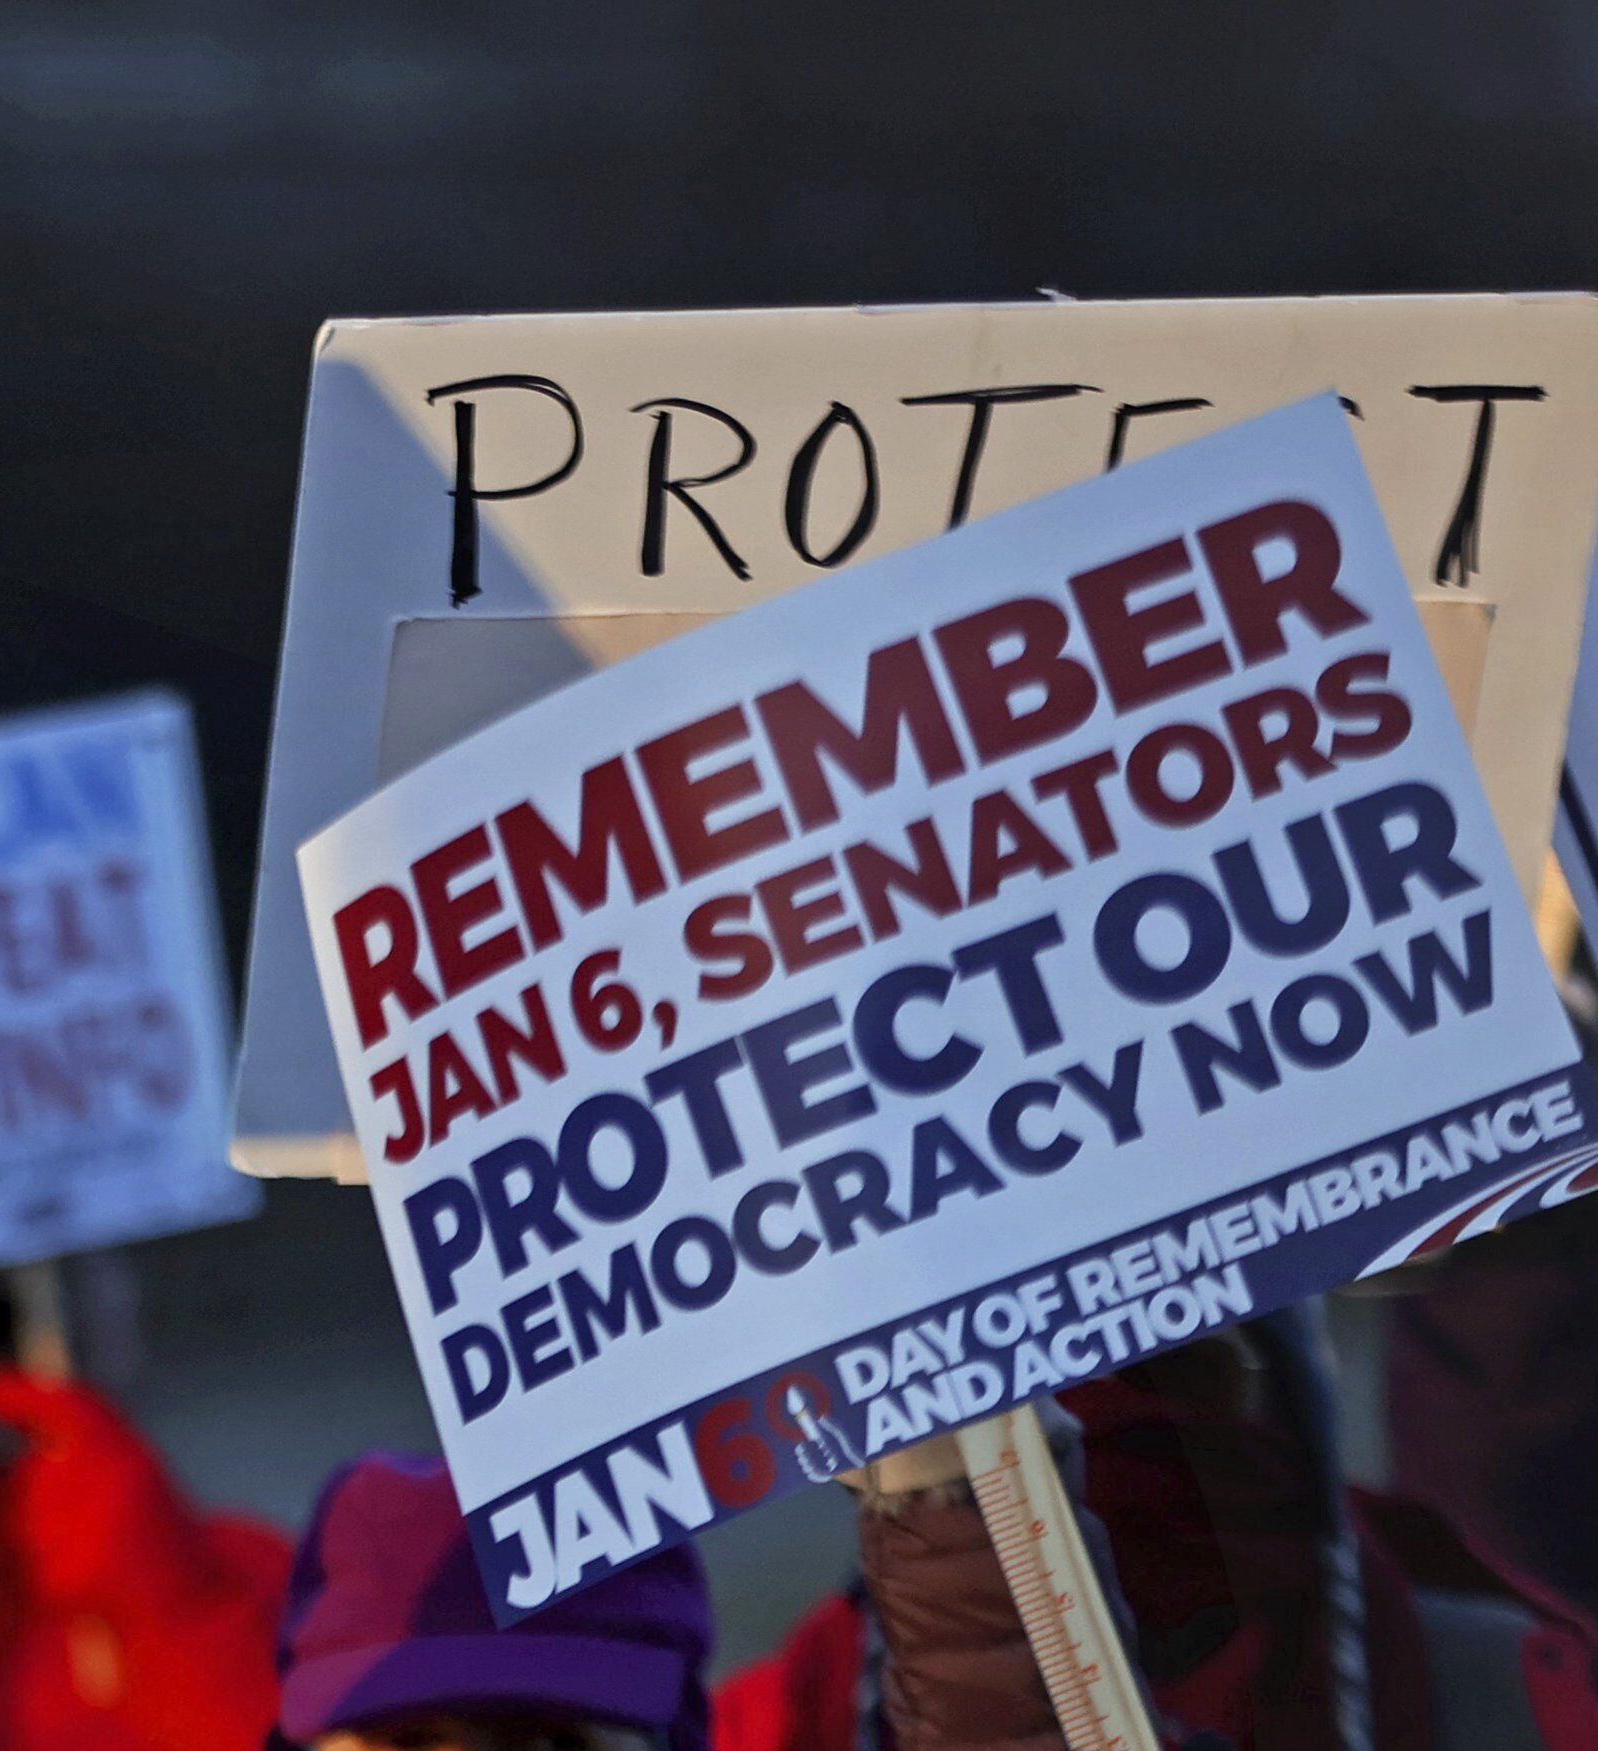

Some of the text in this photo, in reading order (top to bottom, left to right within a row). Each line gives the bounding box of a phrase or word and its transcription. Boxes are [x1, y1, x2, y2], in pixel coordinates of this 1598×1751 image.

[426, 372, 1548, 609] PROTT
[332, 495, 1374, 1052] REMEMBER
[369, 649, 1415, 1165] JAN 6, SENATORS
[401, 778, 1486, 1318] PROTECT OUR
[438, 906, 1495, 1428] DEMOCRACY NOW
[832, 1077, 1586, 1405] DAY OF REMEMBRANCE
[861, 1259, 1254, 1457] AND ACTION
